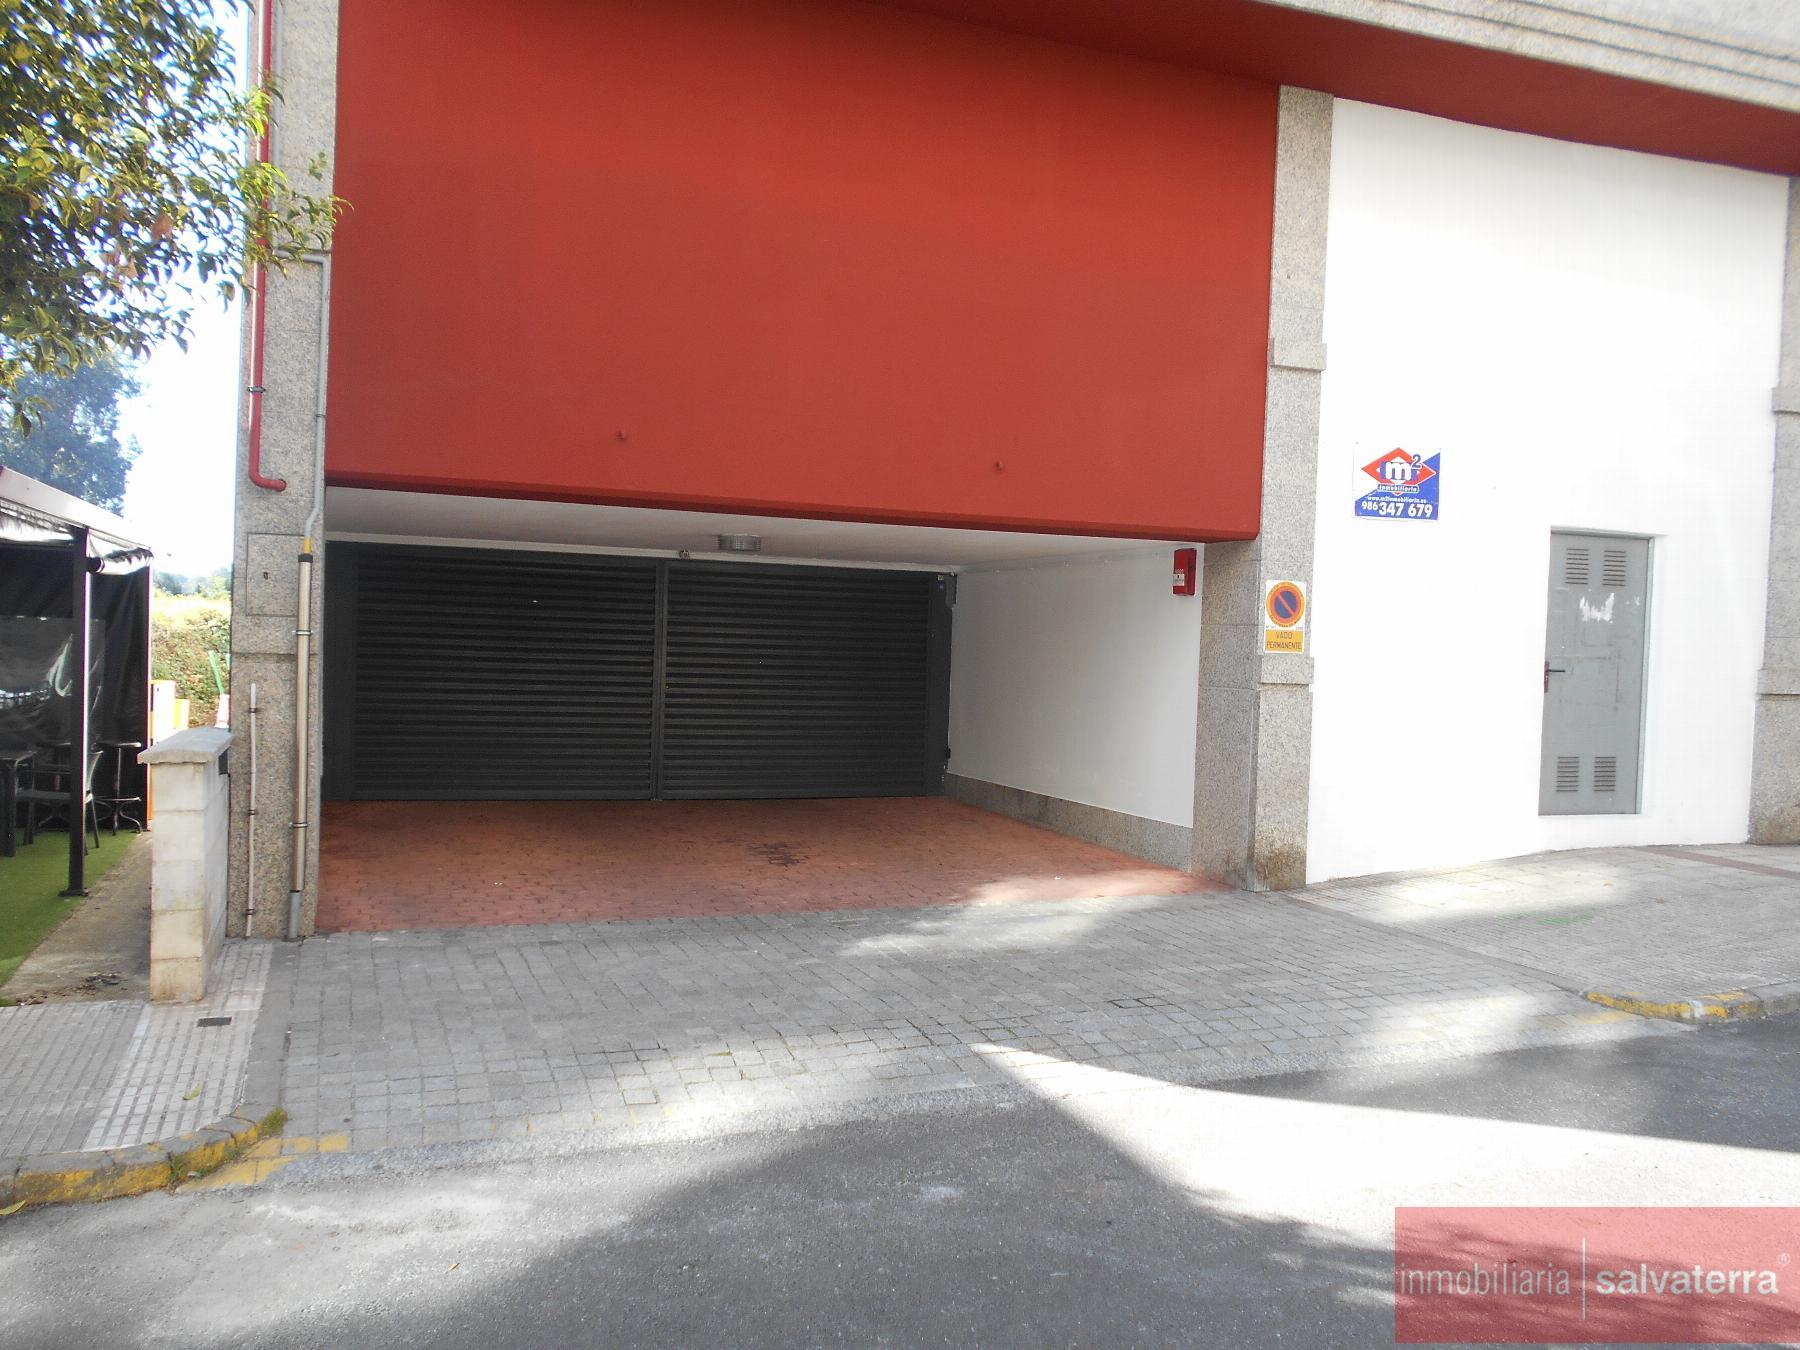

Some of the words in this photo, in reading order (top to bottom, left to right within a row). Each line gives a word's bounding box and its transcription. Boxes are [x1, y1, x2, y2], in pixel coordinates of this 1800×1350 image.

[1362, 501, 1378, 510] 986
[1379, 502, 1404, 516] 347
[1408, 503, 1433, 517] 679
[1267, 641, 1302, 650] PERMANENTE
